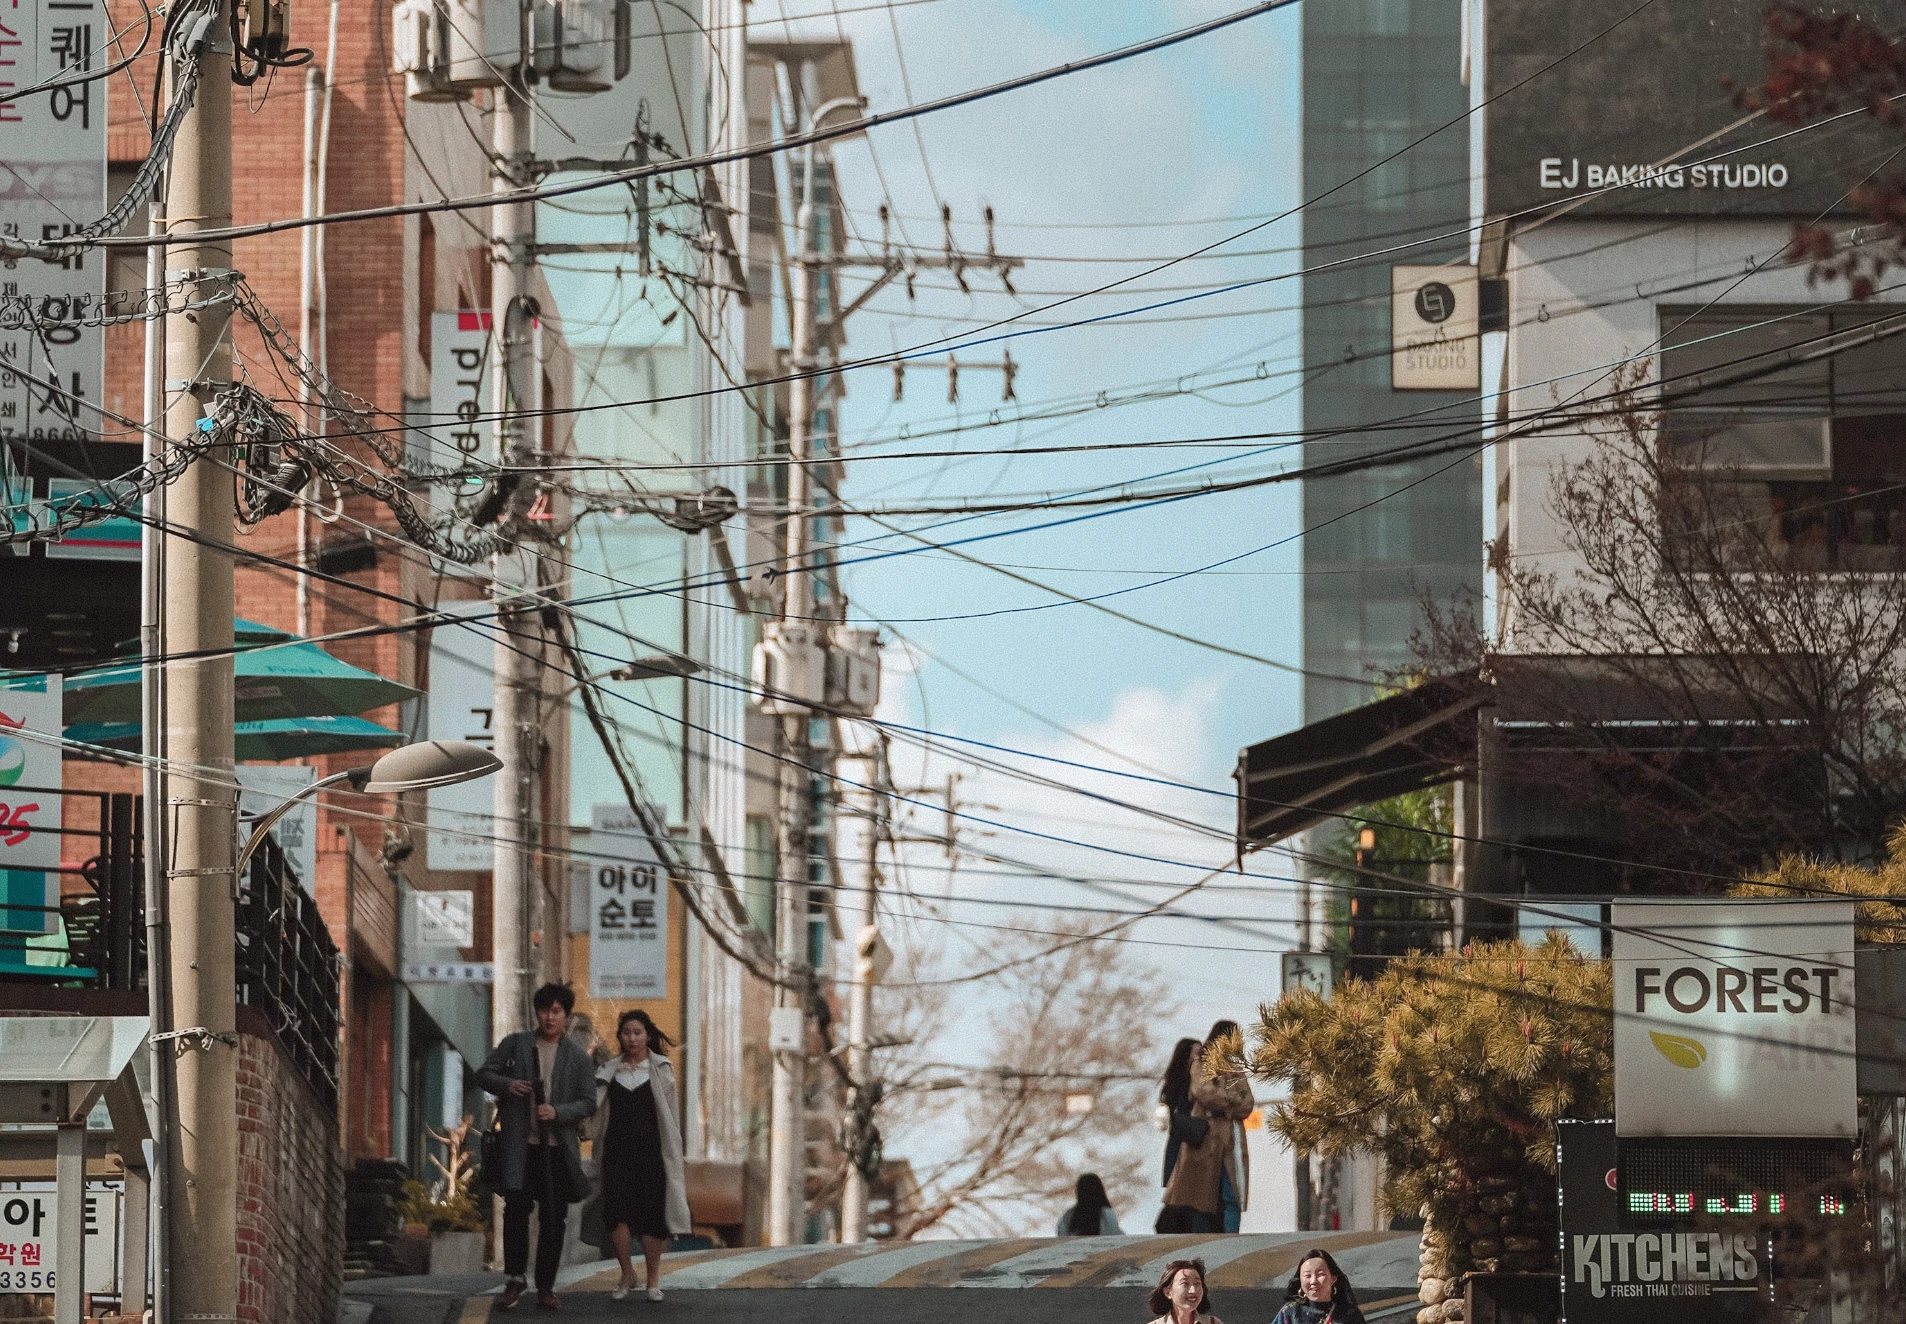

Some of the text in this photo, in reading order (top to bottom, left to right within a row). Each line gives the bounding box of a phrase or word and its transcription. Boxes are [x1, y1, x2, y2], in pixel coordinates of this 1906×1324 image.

[48, 1, 94, 130] 퀘어
[1540, 157, 1789, 189] EJ BAKING STUDIO
[1406, 355, 1467, 371] STUDIO
[598, 897, 658, 930] 순토
[1635, 967, 1839, 1014] FOREST
[1573, 1233, 1758, 1298] KITCHENS
[1611, 1283, 1711, 1297] FRESH THAI CUISINE
